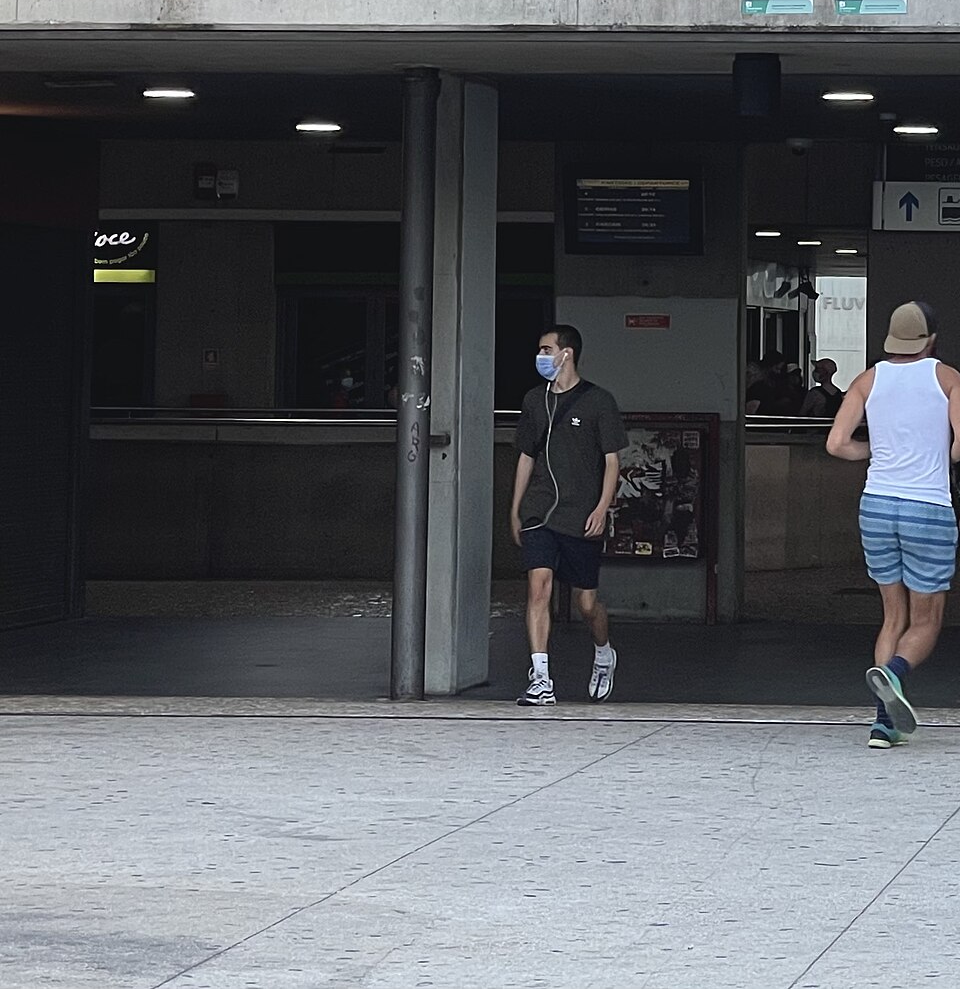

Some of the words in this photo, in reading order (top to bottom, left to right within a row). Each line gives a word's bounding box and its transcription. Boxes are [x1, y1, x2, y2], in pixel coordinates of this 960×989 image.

[924, 157, 948, 168] PESO
[94, 231, 137, 247] oce
[823, 297, 865, 310] FLUV
